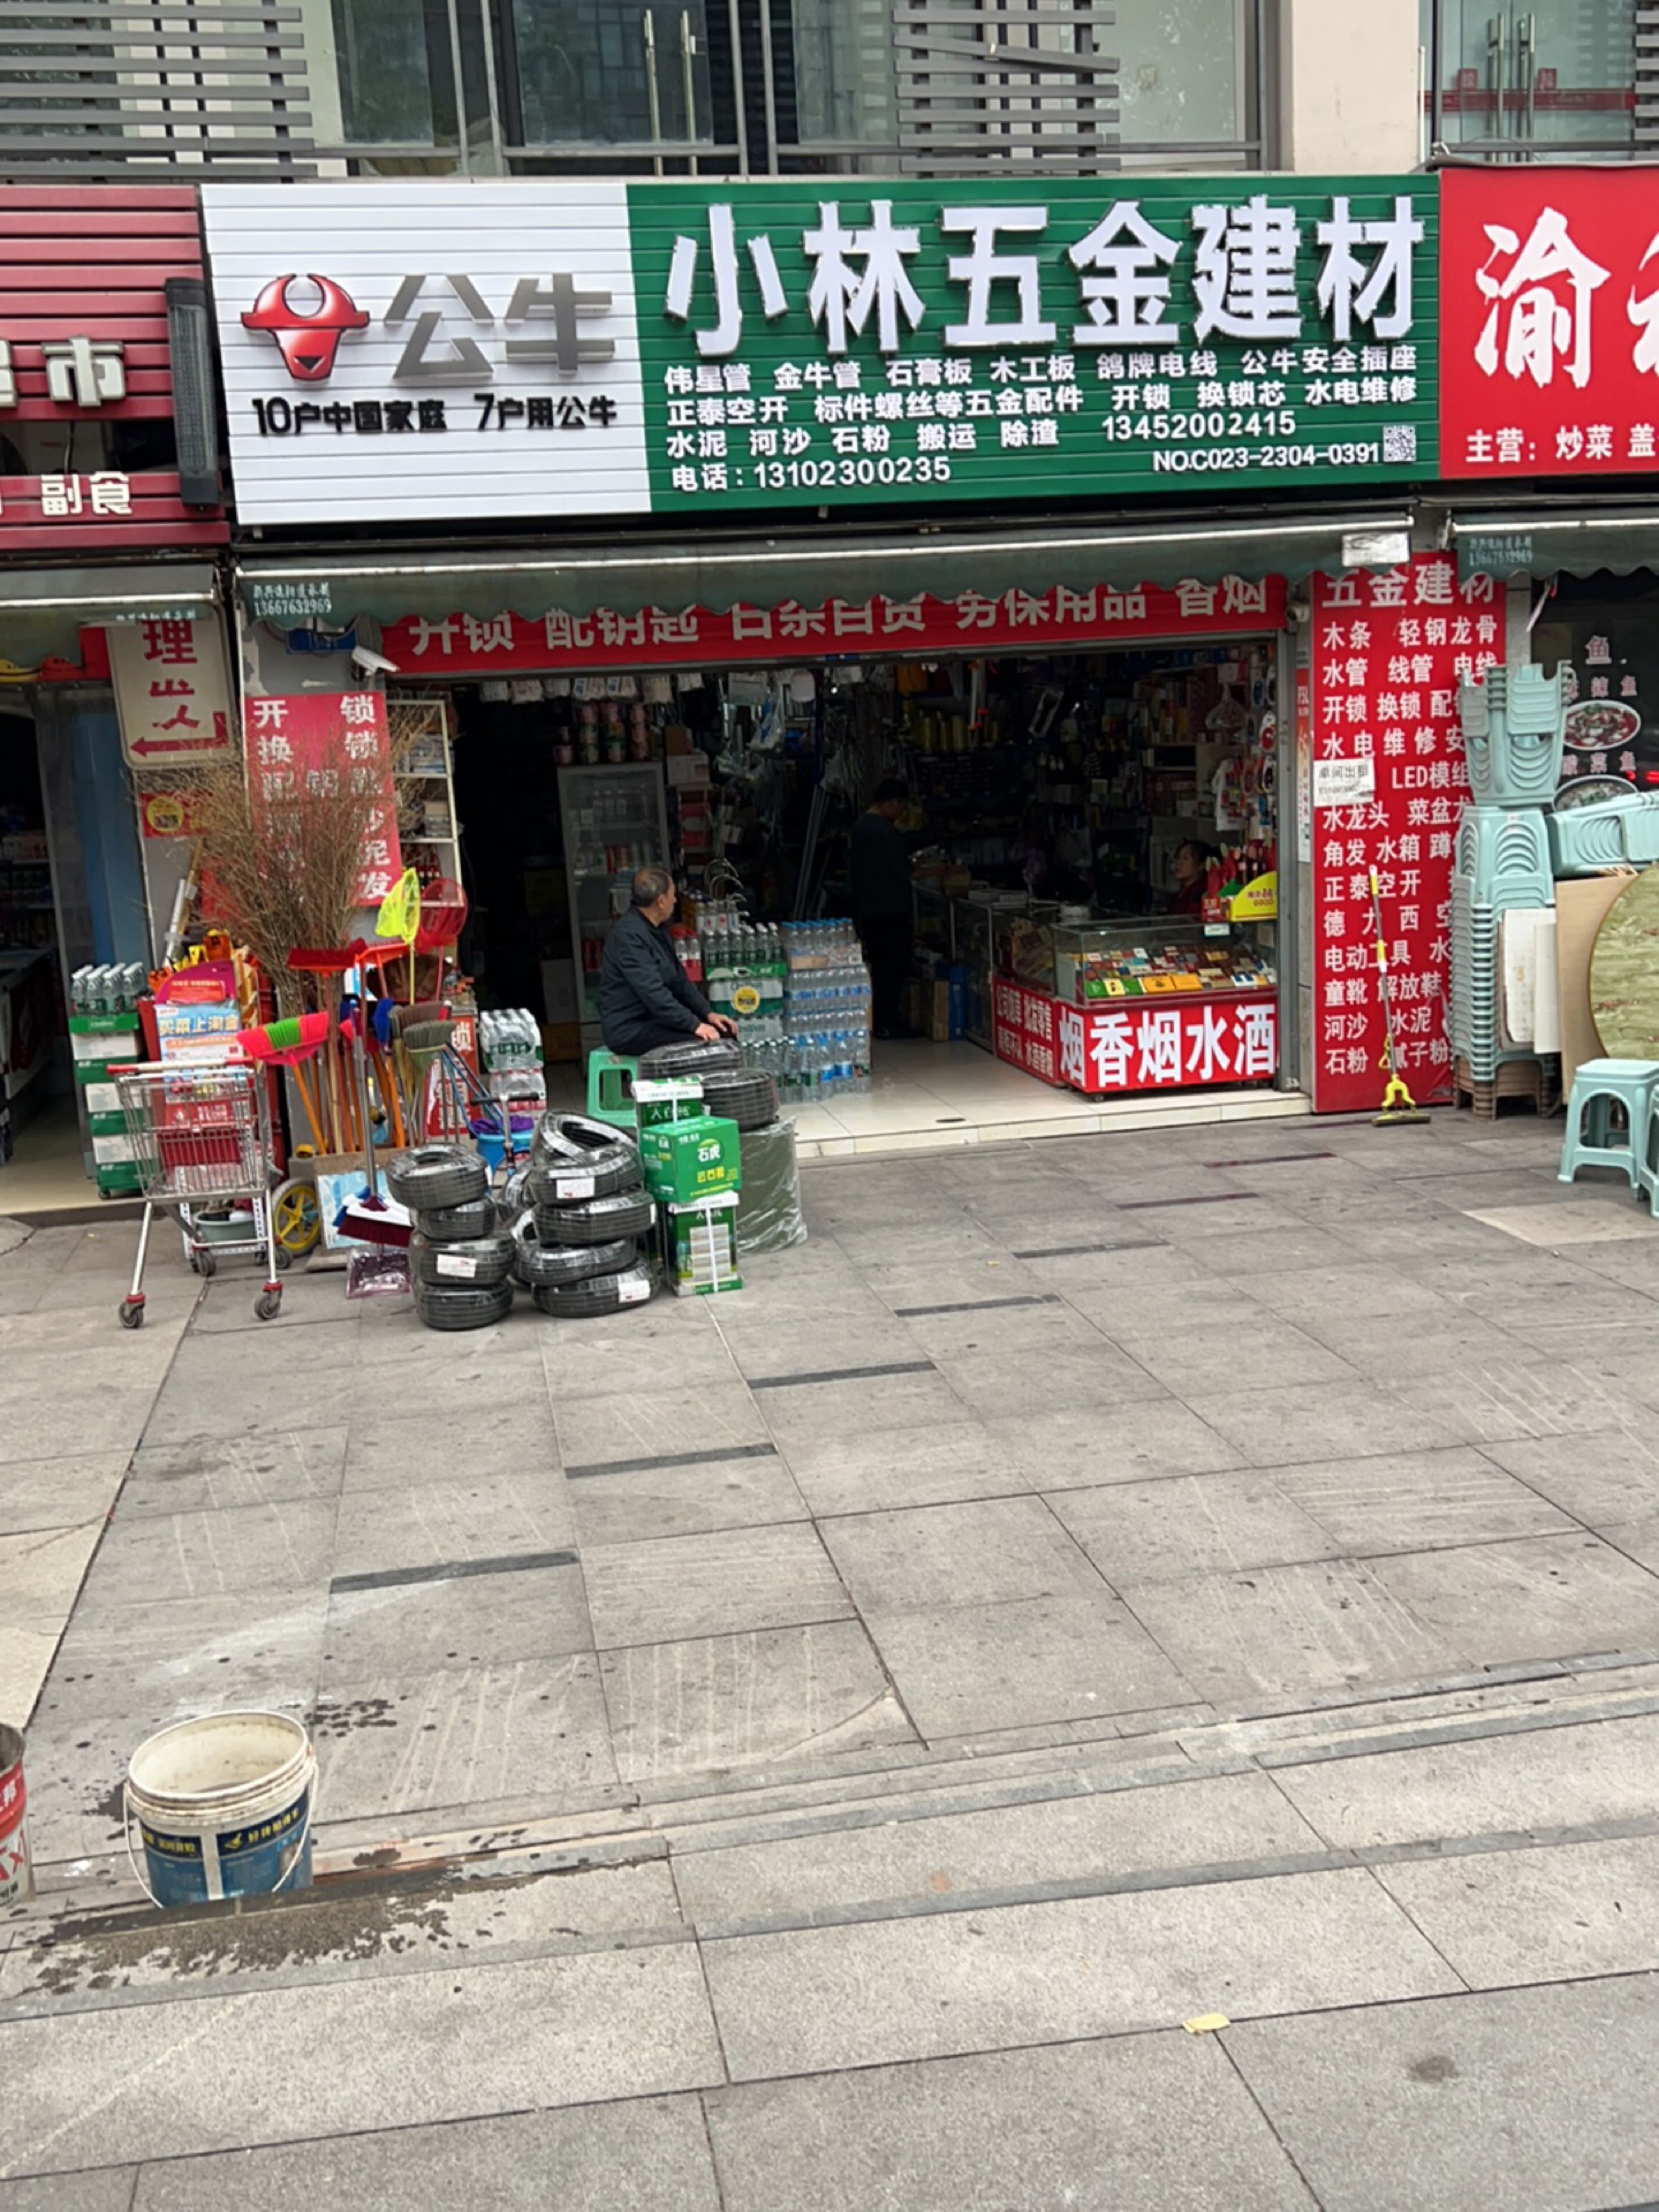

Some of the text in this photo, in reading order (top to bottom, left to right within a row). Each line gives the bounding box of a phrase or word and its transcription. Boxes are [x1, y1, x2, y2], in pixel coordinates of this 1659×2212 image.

[664, 195, 1424, 356] 小林五金建材
[1474, 205, 1659, 389] 渝
[384, 273, 615, 378] 公牛
[0, 337, 126, 407] 市
[664, 344, 1417, 394] 伟星管 金牛管 石膏板 木工板 鸽牌电线 公牛安全插座
[252, 393, 617, 437] 10户中国家庭 7户用公牛
[666, 376, 1416, 427] 正泰空开 标件螺丝等五金配件 开锁 换锁芯 水电维修
[666, 419, 1059, 459] 水泥 河沙 石粉 搬运 除渣
[1102, 410, 1297, 442] 13452002415
[1555, 424, 1614, 460] 炒菜
[1153, 442, 1379, 471] NO.C023-2304-0391
[41, 471, 132, 516] 副食
[1322, 560, 1495, 607] 五金建材
[409, 611, 515, 655] 开锁
[1176, 574, 1267, 616] 香烟
[1322, 614, 1498, 650] 木条 轻钢龙骨
[1322, 657, 1369, 688] 水管
[1388, 653, 1434, 684] 线管
[1322, 694, 1368, 725] 开锁
[1377, 691, 1422, 722] 换锁
[1429, 689, 1462, 719] 配
[1322, 800, 1390, 832] 水龙头
[1376, 833, 1421, 863] 水箱
[1429, 831, 1458, 860] 蹲
[1324, 1006, 1432, 1042] 河沙 水泥
[1090, 1003, 1276, 1088] 香烟水酒
[1325, 1046, 1369, 1075] 石粉
